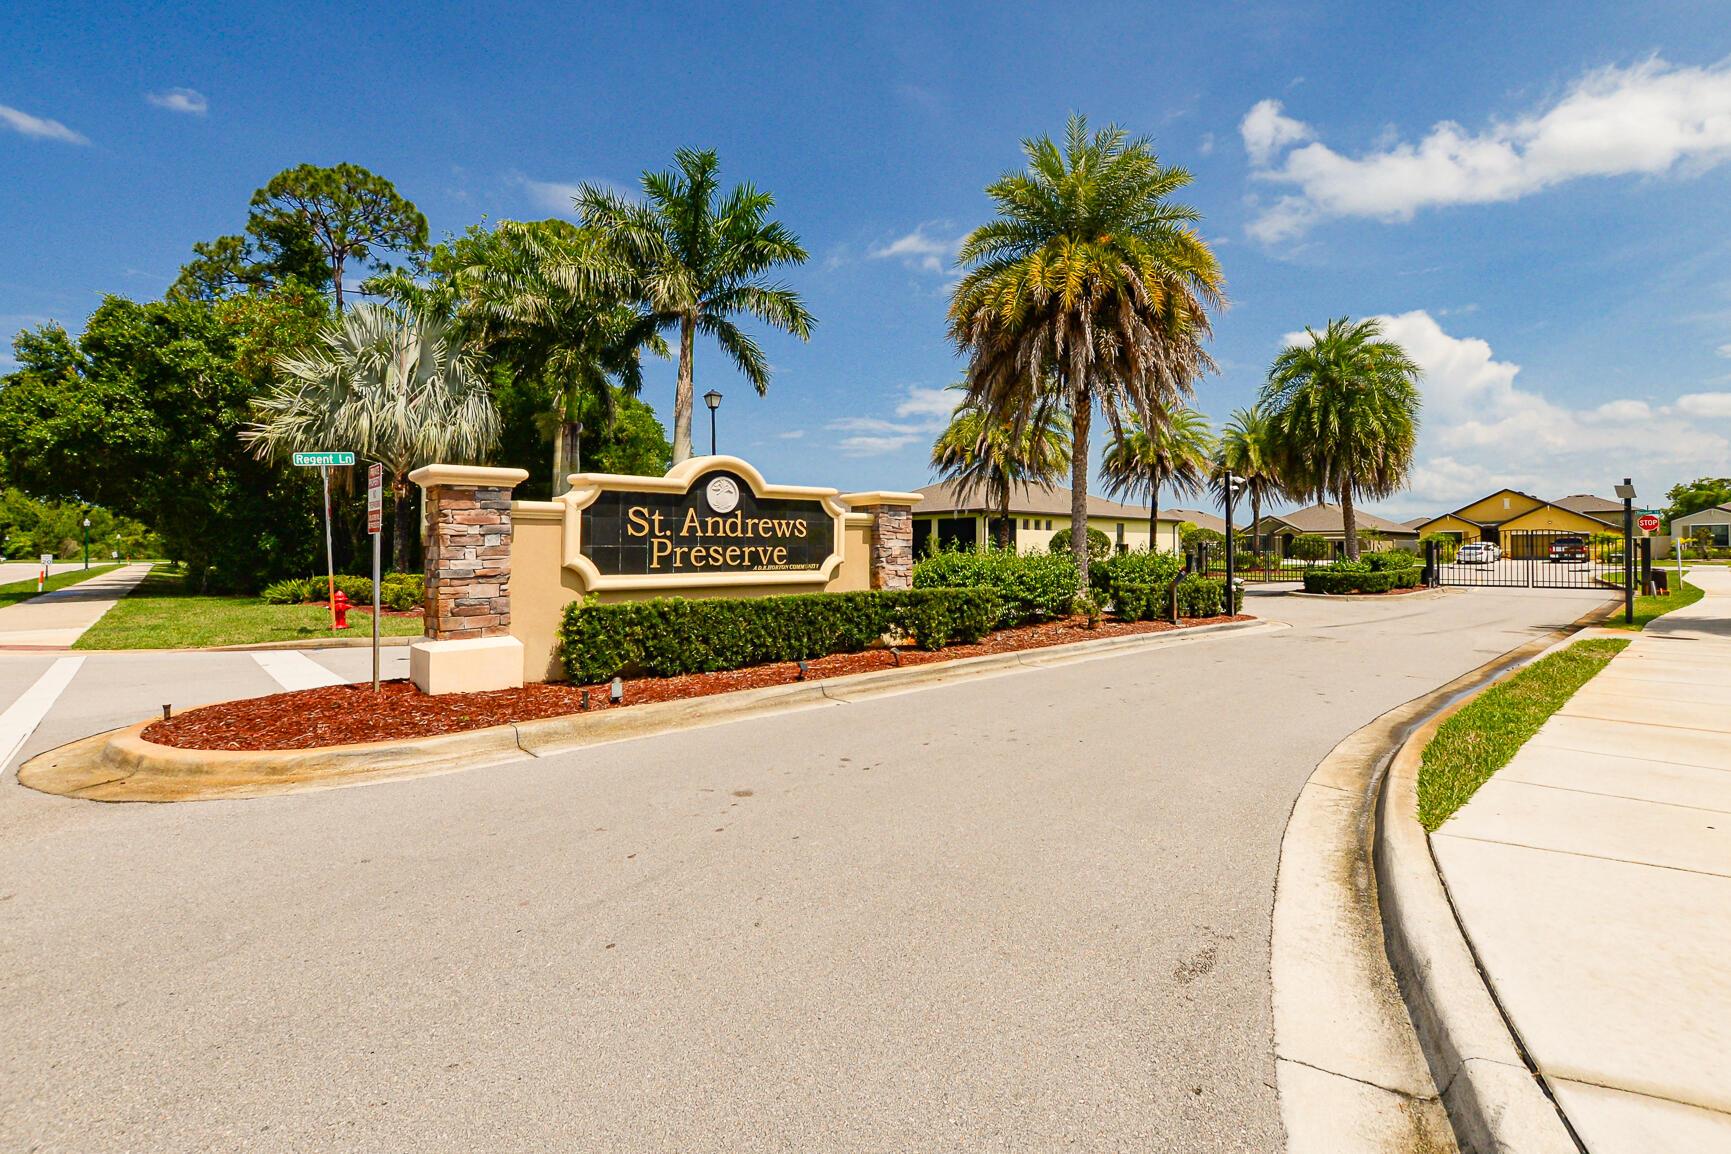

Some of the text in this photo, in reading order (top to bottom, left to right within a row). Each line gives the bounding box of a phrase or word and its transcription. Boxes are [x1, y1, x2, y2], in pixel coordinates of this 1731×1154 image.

[296, 454, 352, 465] Regent Ln
[627, 506, 807, 538] St. Andrews
[1639, 519, 1658, 527] STOP
[650, 538, 787, 569] Preserve
